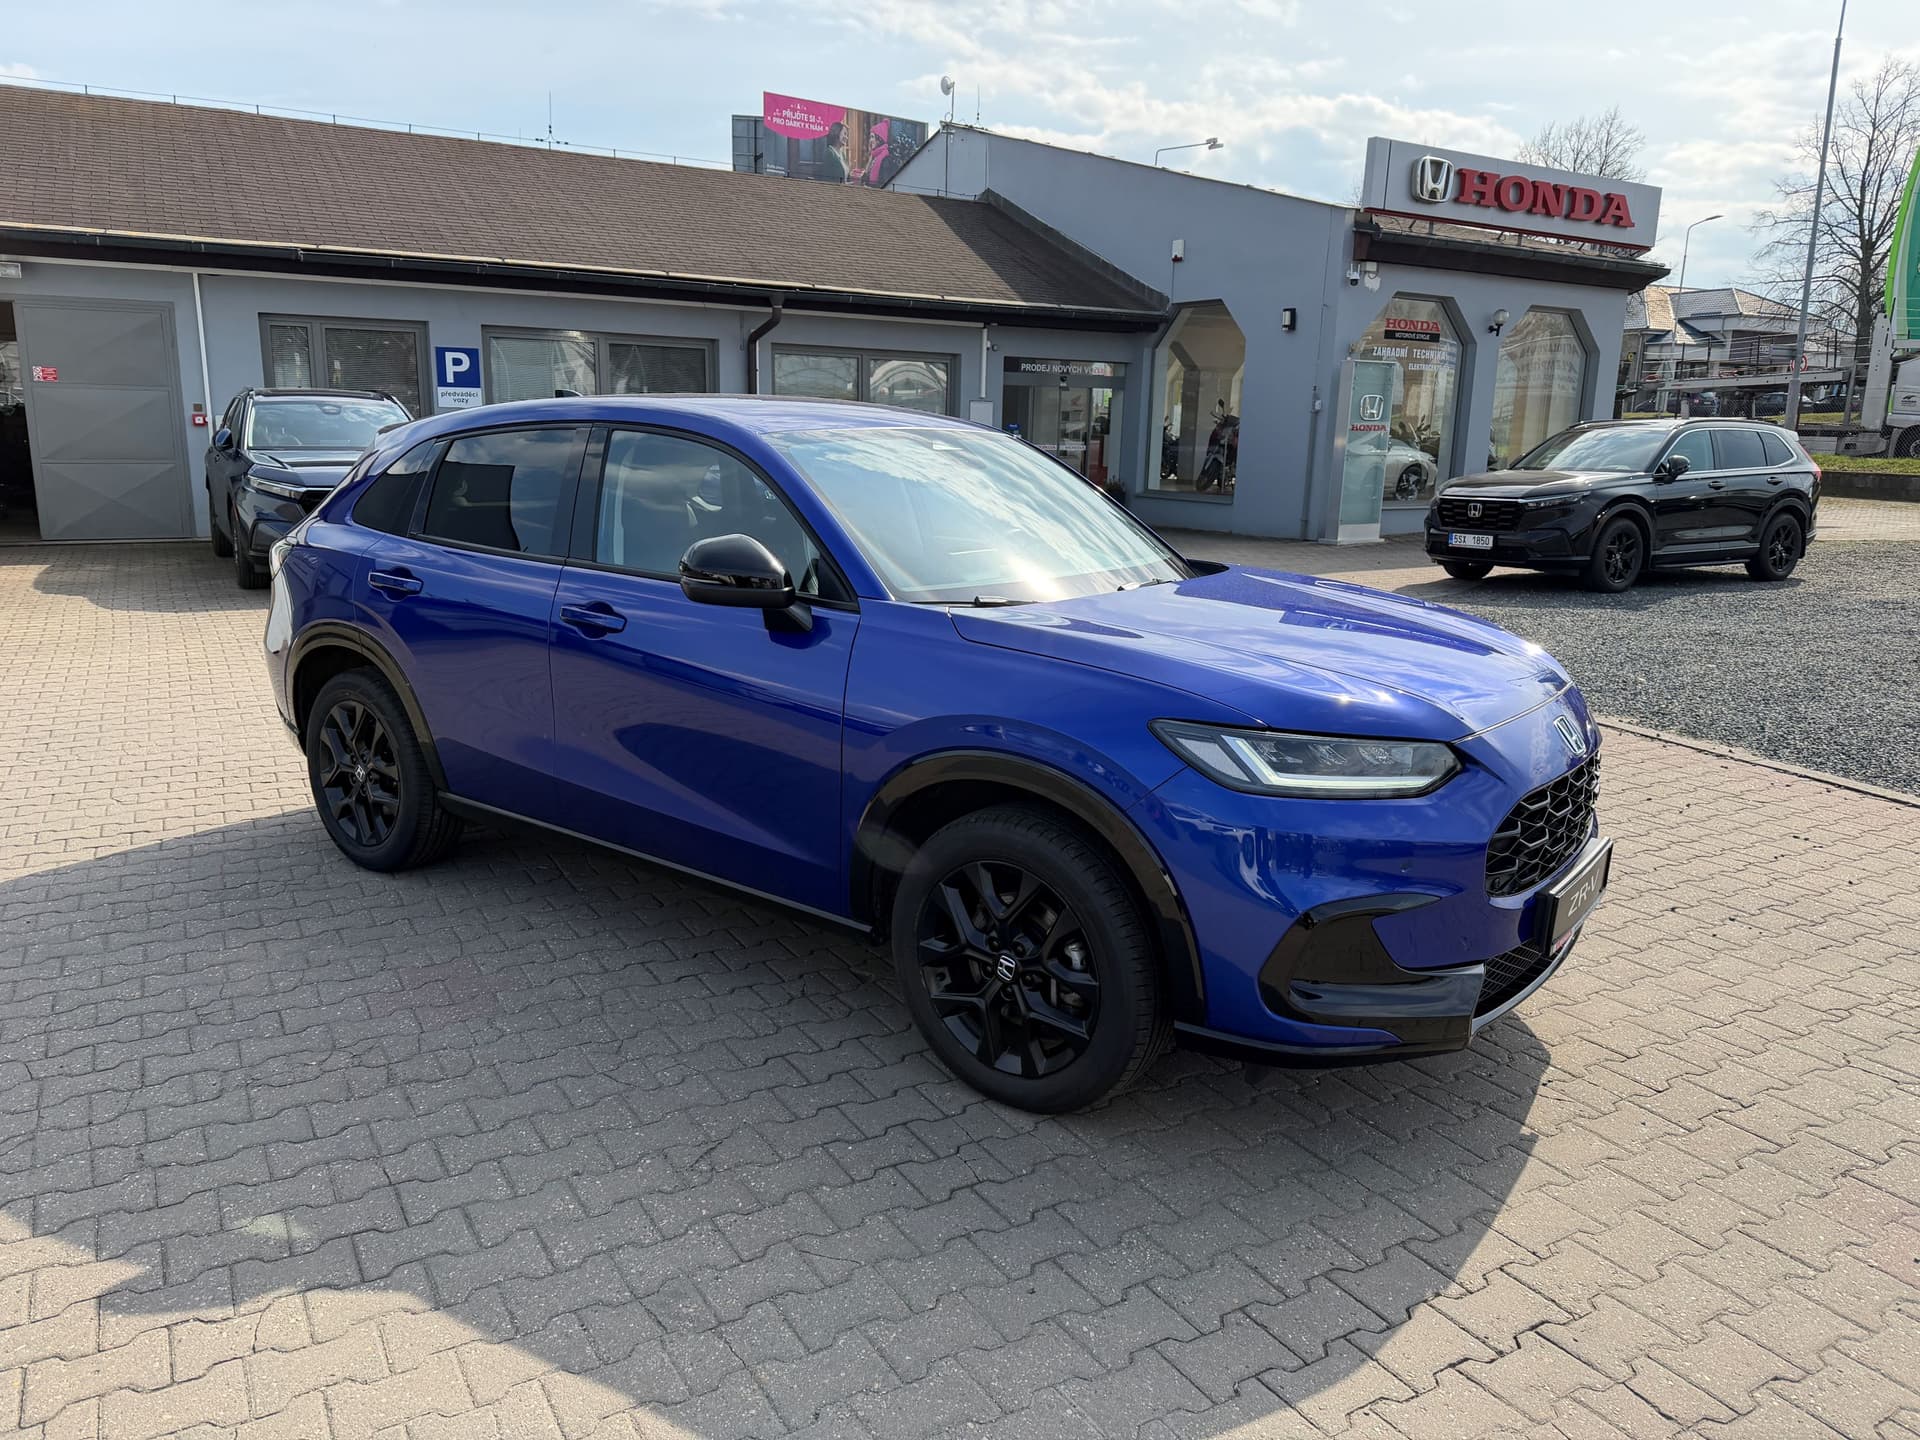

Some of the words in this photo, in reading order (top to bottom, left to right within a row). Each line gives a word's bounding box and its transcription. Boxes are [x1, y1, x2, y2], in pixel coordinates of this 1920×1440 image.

[772, 117, 785, 125] PRO
[1455, 168, 1635, 228] HONDA
[1385, 318, 1440, 332] HONDA
[1373, 346, 1408, 358] ZAHRADNÍ
[1413, 350, 1447, 360] TECHNIKA
[445, 351, 470, 384] P
[1021, 363, 1050, 372] PRODEJ
[1052, 363, 1082, 374] NOVÝCH
[1351, 424, 1386, 432] HONDA
[1454, 535, 1466, 544] 5SX
[1473, 535, 1490, 545] 1850
[1567, 867, 1600, 918] ZR-V
